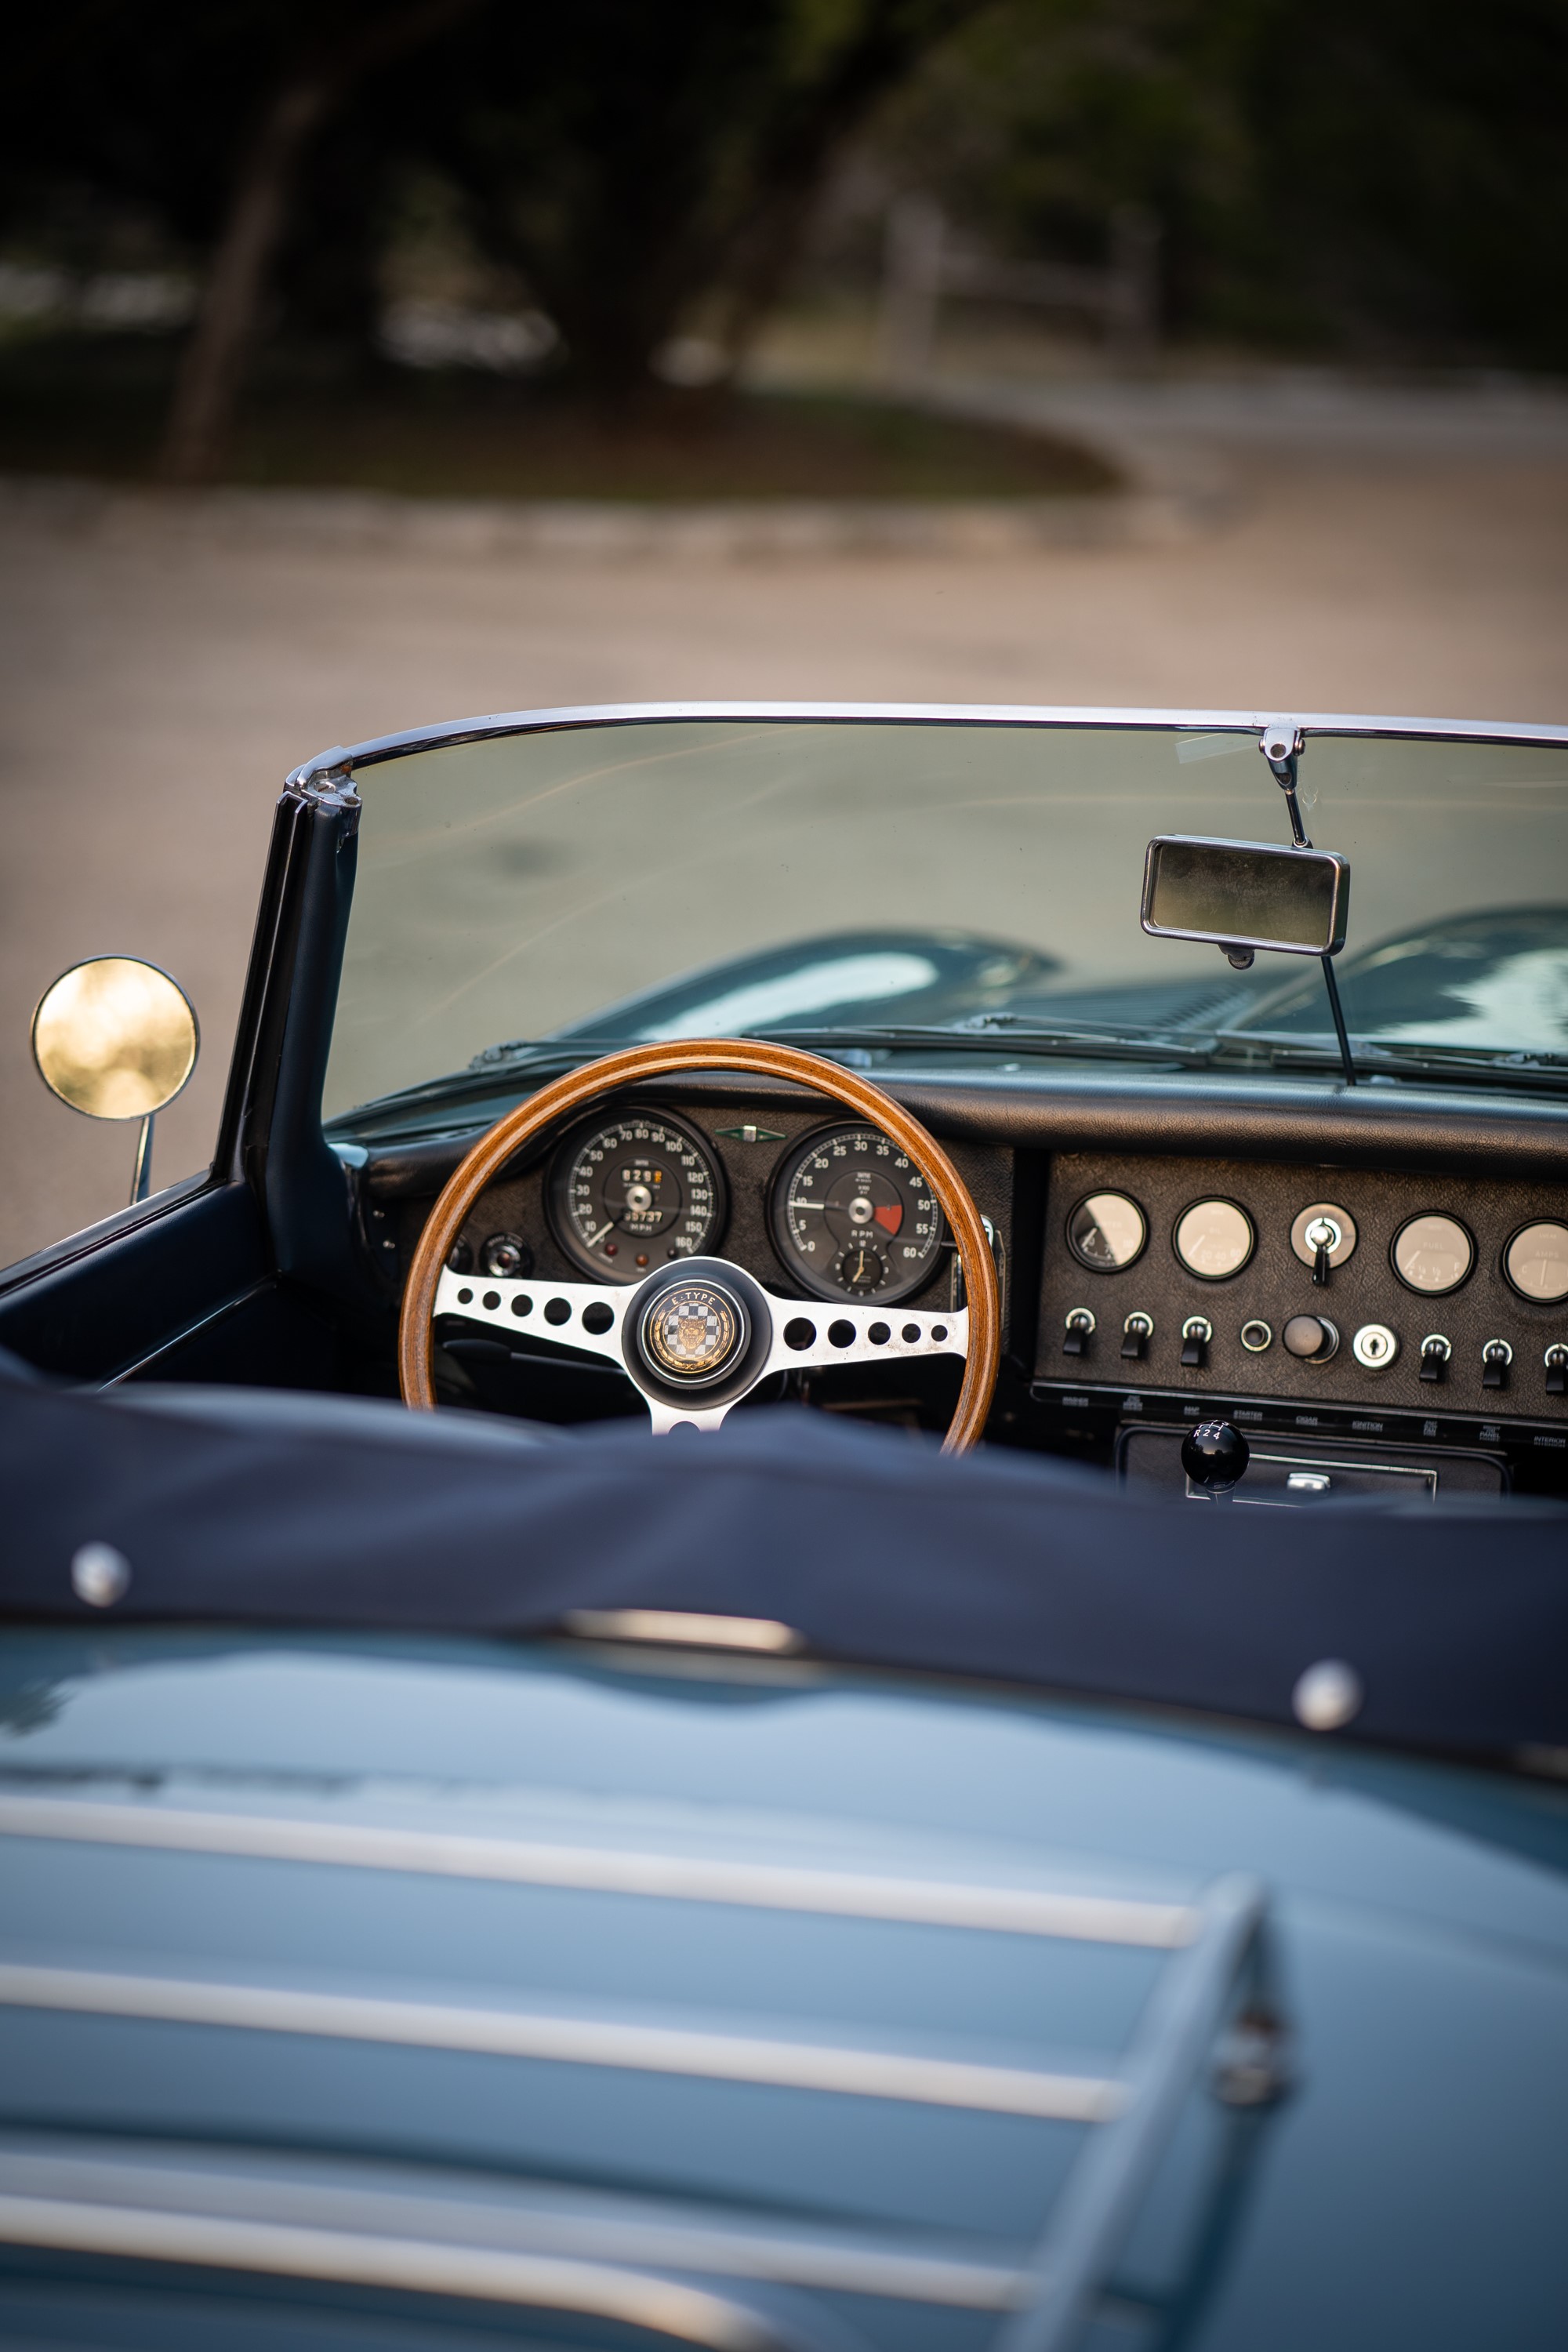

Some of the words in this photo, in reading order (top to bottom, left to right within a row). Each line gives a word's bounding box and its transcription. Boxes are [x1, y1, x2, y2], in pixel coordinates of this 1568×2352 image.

[620, 1130, 633, 1141] 70
[635, 1128, 648, 1139] 80
[652, 1131, 665, 1142] 90
[603, 1138, 617, 1149] 60
[666, 1141, 683, 1152] 100
[855, 1142, 867, 1152] 30
[589, 1150, 604, 1161] 50
[833, 1145, 847, 1156] 25
[877, 1145, 889, 1156] 35
[681, 1154, 695, 1166] 110
[815, 1158, 829, 1168] 20
[895, 1157, 909, 1168] 40
[579, 1166, 593, 1178] 40
[688, 1171, 704, 1183] 120
[803, 1175, 814, 1187] 15
[909, 1177, 922, 1188] 45
[576, 1185, 590, 1196] 30
[691, 1189, 708, 1200] 130
[578, 1203, 593, 1215] 20
[917, 1200, 931, 1210] 50
[690, 1205, 707, 1217] 140
[586, 1221, 597, 1232] 10
[630, 1223, 652, 1232] MPH
[685, 1221, 702, 1232] 150
[799, 1220, 807, 1231] 5
[916, 1223, 928, 1234] 55
[851, 1230, 873, 1239] RPM
[676, 1236, 693, 1247] 160
[808, 1241, 815, 1252] 0
[1423, 1241, 1444, 1250] FUEL
[903, 1247, 916, 1258] 60
[1233, 1410, 1263, 1418] STARTER
[1352, 1421, 1383, 1429] IGNITION
[1193, 1429, 1201, 1438] R
[1213, 1432, 1221, 1440] 4
[1534, 1436, 1566, 1445] INTERIOR
